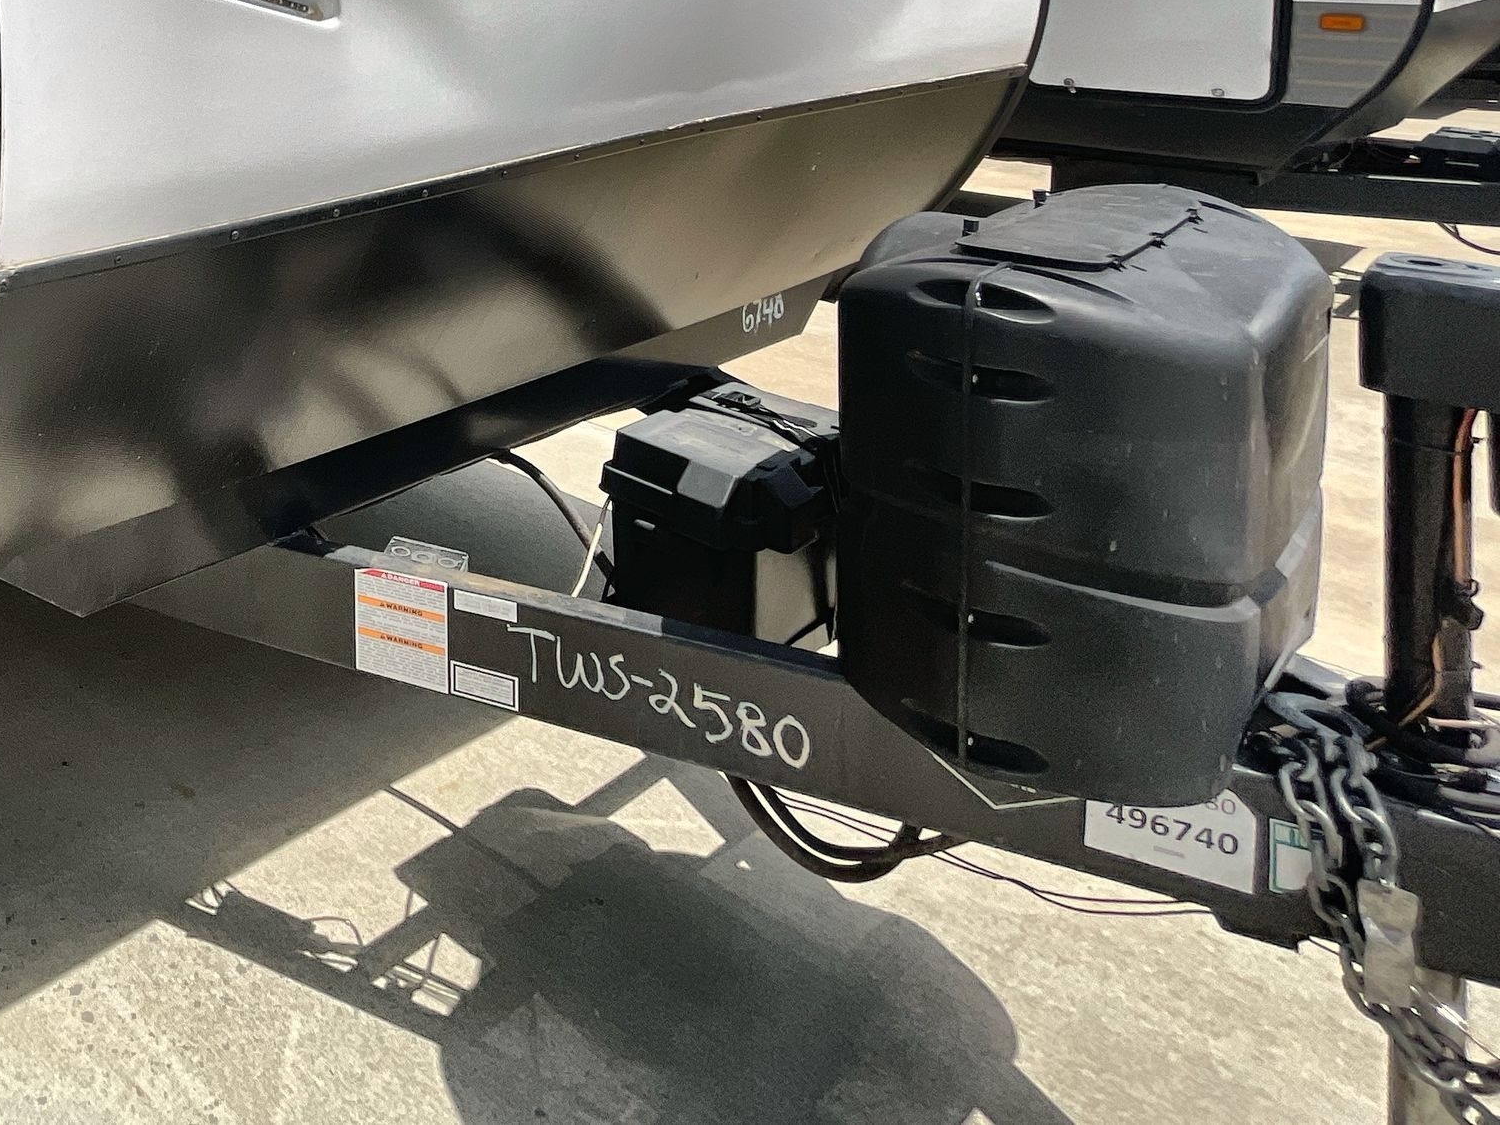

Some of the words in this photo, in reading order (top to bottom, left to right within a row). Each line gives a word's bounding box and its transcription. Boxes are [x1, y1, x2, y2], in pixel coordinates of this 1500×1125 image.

[386, 603, 423, 617] WARNING
[386, 635, 423, 649] WARNING
[505, 623, 812, 769] TWS-2580
[1105, 802, 1239, 855] 496740
